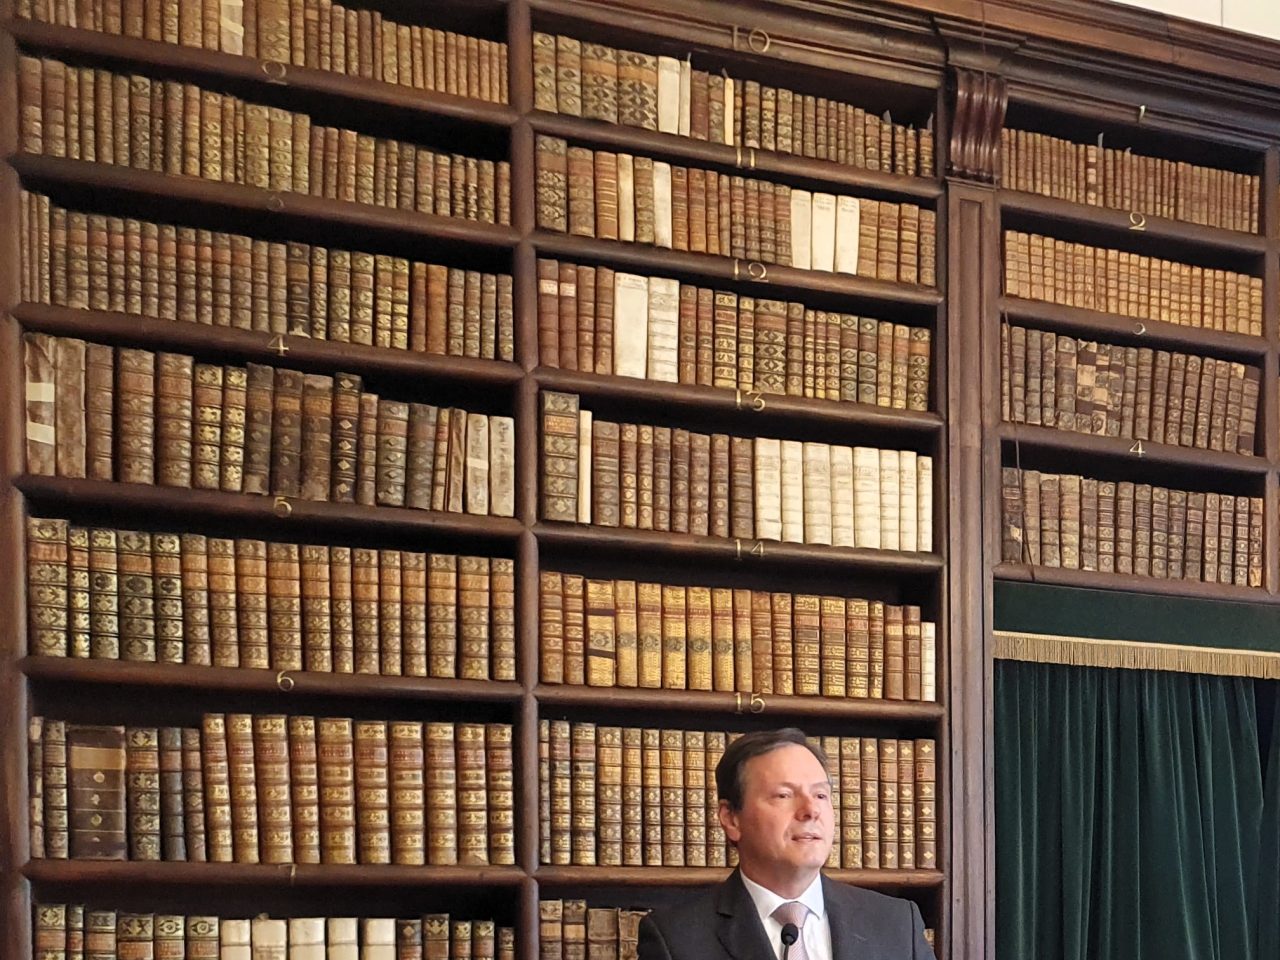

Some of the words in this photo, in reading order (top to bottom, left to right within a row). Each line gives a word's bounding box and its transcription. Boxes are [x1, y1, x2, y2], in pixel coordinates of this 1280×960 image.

[733, 25, 771, 53] 10
[1137, 104, 1146, 123] 1
[736, 146, 756, 170] 11
[1129, 211, 1147, 231] 2
[734, 258, 769, 283] 12
[267, 334, 290, 356] 4
[736, 388, 766, 412] 13
[1129, 439, 1146, 458] 4
[273, 496, 292, 518] 5
[735, 538, 768, 561] 14
[277, 670, 294, 691] 6
[734, 691, 765, 714] 15
[278, 863, 297, 886] 7
